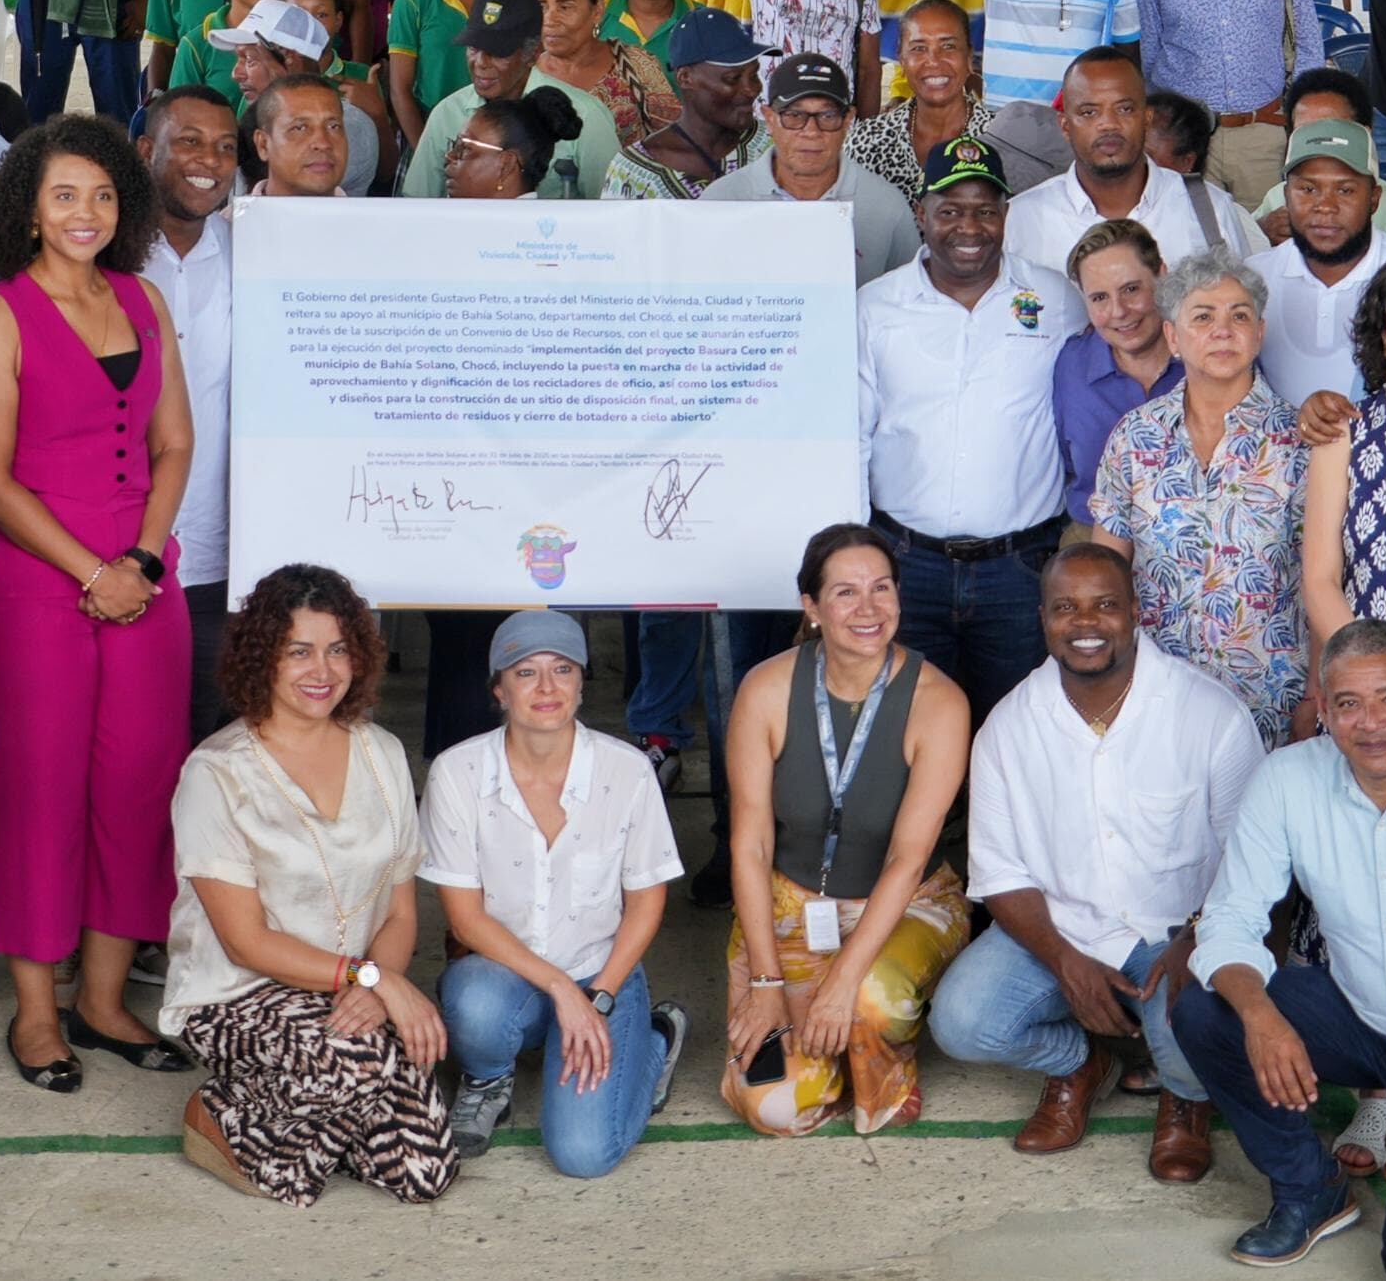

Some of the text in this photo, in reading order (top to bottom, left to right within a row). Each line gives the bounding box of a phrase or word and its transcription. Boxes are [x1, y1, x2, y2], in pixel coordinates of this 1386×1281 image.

[516, 240, 578, 251] Ministerio de
[525, 250, 560, 260] Ciudad
[281, 291, 294, 302] El
[295, 291, 347, 302] Gobierno
[349, 292, 367, 303] del
[369, 292, 429, 305] presidente
[430, 292, 477, 303] Gustavo
[478, 293, 512, 305] Petro,
[522, 293, 558, 304] través
[559, 293, 578, 304] del
[580, 293, 635, 304] Ministerio
[636, 294, 651, 305] de
[652, 294, 703, 307] Vivienda,
[704, 294, 744, 305] Ciudad
[755, 295, 805, 306] Territorio
[284, 308, 803, 323] reitera su apoyo al municipio de Bahía Solano, departamento del Chocó, el cual se materializará
[296, 325, 332, 336] través
[333, 325, 349, 336] de
[350, 325, 362, 336] la
[363, 325, 426, 339] suscripción
[427, 326, 442, 337] de
[444, 328, 459, 337] un
[460, 326, 513, 337] Convenio
[514, 326, 530, 337] de
[531, 326, 554, 337] Uso
[555, 326, 570, 337] de
[572, 327, 626, 339] Recursos,
[627, 330, 648, 338] con
[648, 327, 661, 338] el
[662, 330, 684, 341] que
[685, 330, 700, 338] se
[699, 327, 746, 338] aunarán
[747, 328, 800, 339] esfuerzos
[289, 344, 316, 355] para
[317, 341, 329, 352] la
[330, 341, 383, 355] ejecución
[384, 342, 403, 353] del
[404, 342, 454, 355] proyecto
[455, 342, 525, 353] denominado
[624, 343, 644, 354] del
[645, 343, 696, 357] proyecto
[698, 344, 738, 355] Basura
[740, 344, 768, 355] Cero
[769, 347, 784, 355] en
[786, 344, 798, 355] el
[304, 358, 784, 373] municipio de Bahía Solano, Chocó, incluyendo la puesta en marcha de la actividad de
[309, 375, 409, 389] aprovechamiento
[420, 376, 493, 389] dignificación
[495, 376, 510, 387] de
[512, 376, 531, 387] los
[532, 376, 602, 387] recicladores
[604, 377, 619, 388] de
[621, 377, 656, 389] oficio,
[657, 377, 676, 388] así
[677, 380, 708, 388] como
[710, 377, 729, 388] los
[729, 377, 779, 388] estudios
[338, 392, 383, 403] diseños
[385, 395, 412, 406] para
[414, 392, 427, 403] la
[428, 393, 501, 404] construcción
[503, 393, 518, 404] de
[520, 396, 536, 404] un
[538, 393, 563, 404] sitio
[565, 393, 581, 404] de
[582, 393, 647, 407] disposición
[649, 394, 678, 406] final,
[680, 396, 696, 405] un
[698, 394, 742, 405] sistema
[744, 394, 760, 405] de
[373, 409, 443, 420] tratamiento
[444, 409, 460, 420] de
[462, 410, 511, 421] residuos
[522, 410, 556, 421] cierre
[558, 410, 574, 421] de
[575, 410, 628, 421] botadero
[640, 411, 668, 422] cielo
